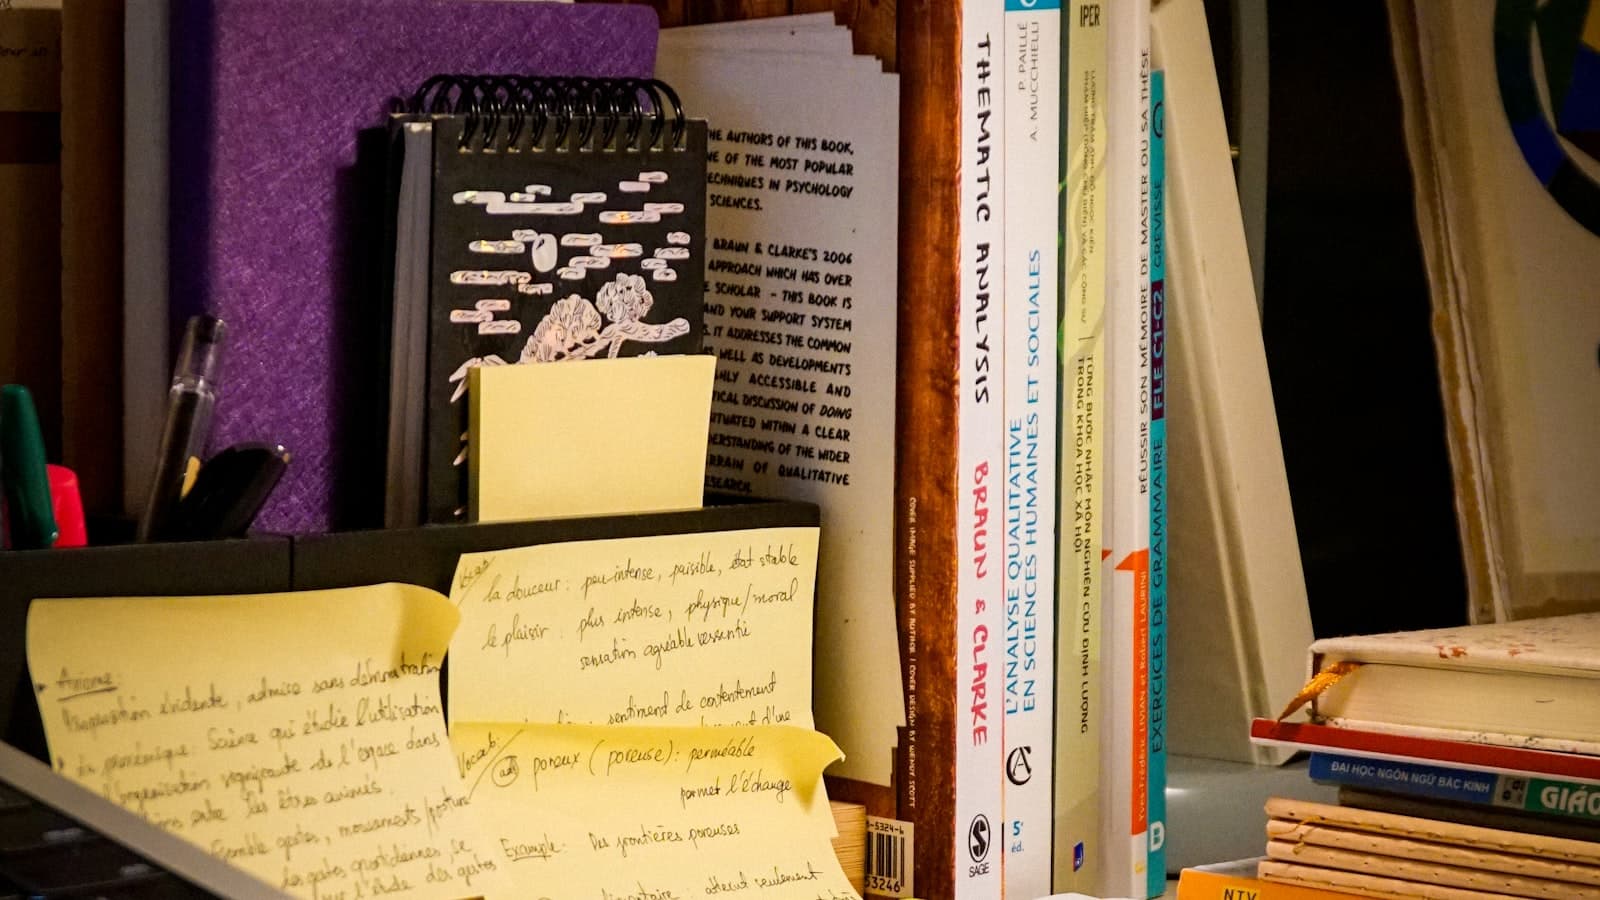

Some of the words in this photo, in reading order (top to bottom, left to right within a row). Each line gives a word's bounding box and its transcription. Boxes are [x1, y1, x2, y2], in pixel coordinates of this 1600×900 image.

[1030, 21, 1039, 121] MUCCHIELLI
[976, 32, 992, 222] THEMATIC
[1141, 110, 1149, 132] SA
[726, 130, 773, 147] AUTHORS
[777, 135, 790, 148] OF
[795, 137, 818, 151] THIS
[820, 139, 854, 156] BOOK,
[1141, 140, 1149, 166] OU
[725, 152, 739, 165] OF
[745, 154, 765, 168] THE
[770, 156, 798, 170] MOST
[804, 159, 854, 176] POPULAR
[710, 194, 763, 211] SCIENCES.
[769, 178, 780, 191] IN
[785, 180, 854, 199] PSYCHOLOGY
[1140, 175, 1149, 245] MASTER
[1154, 180, 1162, 268] GREVISSE
[713, 237, 750, 254] BRAUN
[768, 244, 818, 261] CLARKE'S
[824, 251, 852, 264] 2006
[708, 260, 762, 277] APPROACH
[766, 266, 797, 280] WHICH
[802, 270, 820, 284] HAS
[824, 273, 852, 288] OVER
[1141, 256, 1149, 276] DE
[715, 282, 761, 298] SCHOLAR
[783, 290, 803, 304] THIS
[808, 293, 838, 307] BOOK
[842, 297, 852, 310] IS
[1027, 250, 1040, 367] SOCIALES
[730, 305, 756, 320] YOUR
[762, 309, 806, 325] SUPPORT
[812, 315, 852, 331] SYSTEM
[975, 242, 990, 404] ANALYSIS
[1138, 286, 1149, 368] MÉMOIRE
[1152, 289, 1164, 355] C1-C2
[714, 325, 723, 337] IT
[727, 327, 782, 344] ADDRESSES
[786, 334, 804, 348] THE
[807, 337, 852, 353] COMMON
[720, 348, 746, 362] WELL
[752, 352, 764, 365] AS
[769, 354, 852, 376] DEVELOPMENTS
[749, 373, 817, 393] ACCESSIBLE
[826, 383, 852, 398] AND
[1027, 376, 1039, 404] ET
[1076, 356, 1085, 410] TRONG
[1140, 376, 1148, 415] SON
[1153, 371, 1164, 410] FLE
[742, 394, 798, 413] DISCUSSION
[802, 402, 815, 415] OF
[818, 405, 852, 420] DOING
[761, 419, 796, 434] WITHIN
[802, 424, 810, 436] A
[815, 425, 850, 442] CLEAR
[1075, 414, 1084, 459] KHOA
[778, 443, 792, 455] OF
[796, 445, 814, 459] THE
[818, 448, 850, 464] WIDER
[1138, 422, 1148, 496] RÉUSSIR
[754, 462, 768, 474] OF
[778, 463, 850, 486] QUALITATIVE
[1026, 414, 1039, 545] HUMAINES
[1007, 418, 1022, 580] QUALITATIVE
[1152, 439, 1164, 588] GRAMMAIRE
[972, 461, 988, 579] BRAUN
[1024, 554, 1037, 670] SCIENCES
[1152, 600, 1163, 625] DE
[1006, 582, 1020, 714] L'ANALYSE
[971, 624, 988, 747] CLARKE
[1023, 681, 1035, 712] EN
[1152, 634, 1162, 752] EXERCICES
[1463, 781, 1490, 793] KINH
[968, 862, 990, 878] SAGE
